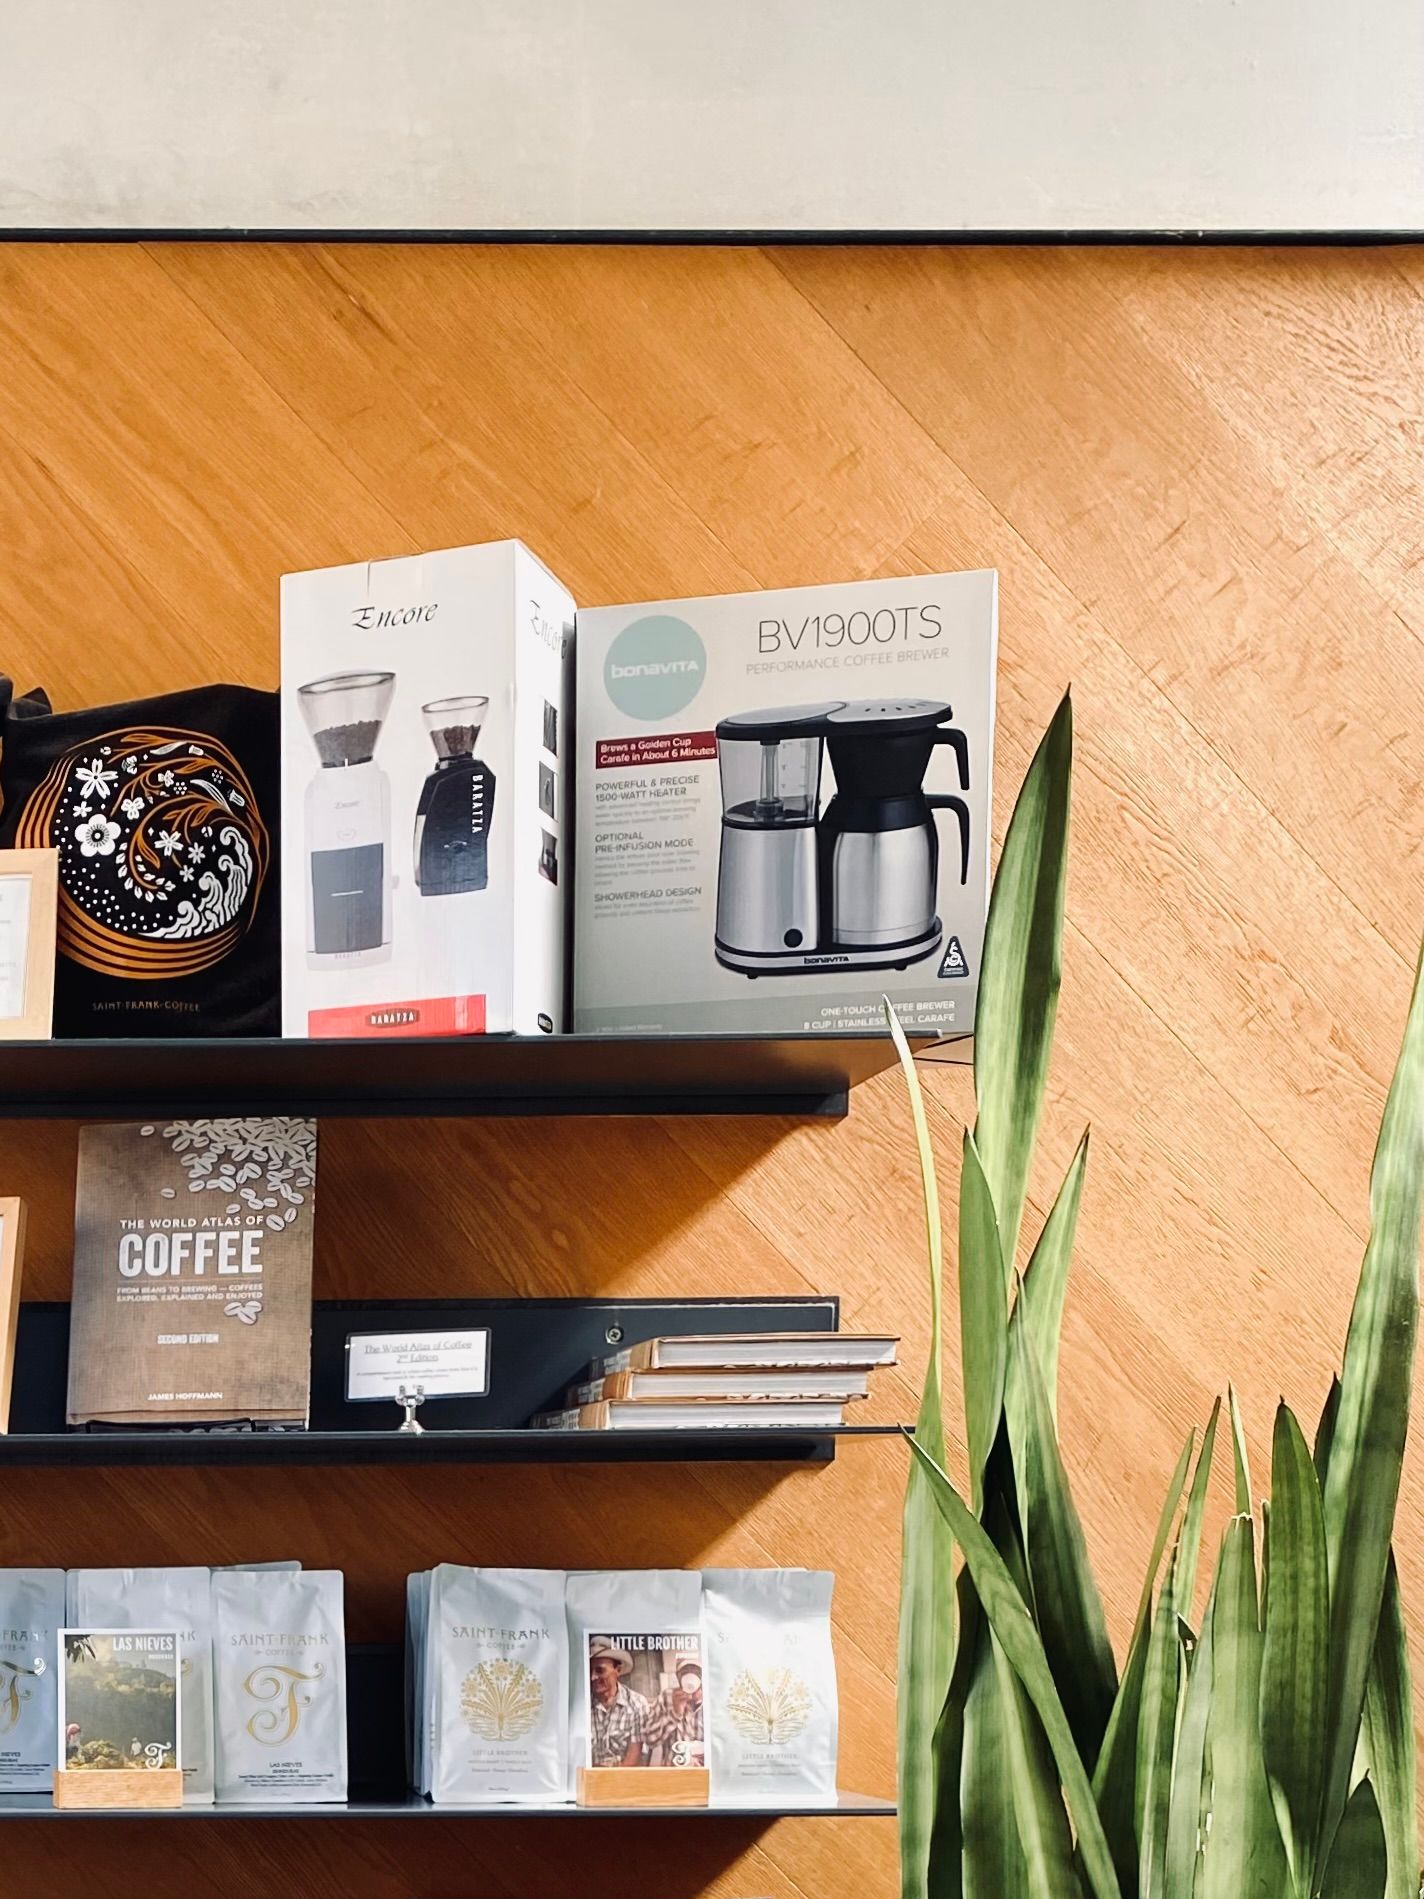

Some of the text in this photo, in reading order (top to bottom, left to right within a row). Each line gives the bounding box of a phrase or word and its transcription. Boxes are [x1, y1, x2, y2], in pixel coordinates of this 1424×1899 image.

[351, 603, 439, 630] Encore
[758, 604, 943, 653] BV1900TS
[745, 647, 950, 676] PERFORMANCE COFFEE BREWER
[601, 743, 628, 753] Brews
[638, 739, 671, 749] Golden
[672, 737, 692, 748] Cup
[600, 747, 716, 764] Carafe in About 6 Minutes
[595, 779, 648, 791] POWERFUL
[660, 775, 701, 786] PRECISE
[649, 787, 687, 797] HEATER
[471, 774, 484, 833] BARATZA
[595, 831, 644, 843] OPTIONAL
[595, 838, 694, 854] PRE-INFUSION MODE
[594, 887, 702, 902] SHOWERHEAD DESIGN
[92, 1001, 122, 1011] SAINT
[820, 1000, 955, 1017] ONE-TOUCH CFFEE BREWER
[371, 1011, 415, 1025] BARATZA
[811, 1020, 832, 1029] CUP
[837, 1017, 887, 1028] STAINLESS
[917, 1013, 955, 1023] CARAFE
[119, 1215, 264, 1229] THE WORLD ATLAS OF
[118, 1230, 264, 1277] COFFEE
[141, 1286, 167, 1294] BEANS
[181, 1285, 218, 1293] BREWING
[228, 1283, 263, 1291] COFFEES
[161, 1293, 205, 1301] EXPLAINED
[157, 1333, 220, 1344] SECOND EDITION
[148, 1391, 224, 1400] JAMES HOFFMANN
[231, 1633, 329, 1645] SAINT FRANK
[452, 1627, 550, 1640] SAINT FRANK
[113, 1637, 132, 1650] LAS
[135, 1636, 173, 1651] NIEVES
[610, 1635, 698, 1650] LITTLE BROTHER
